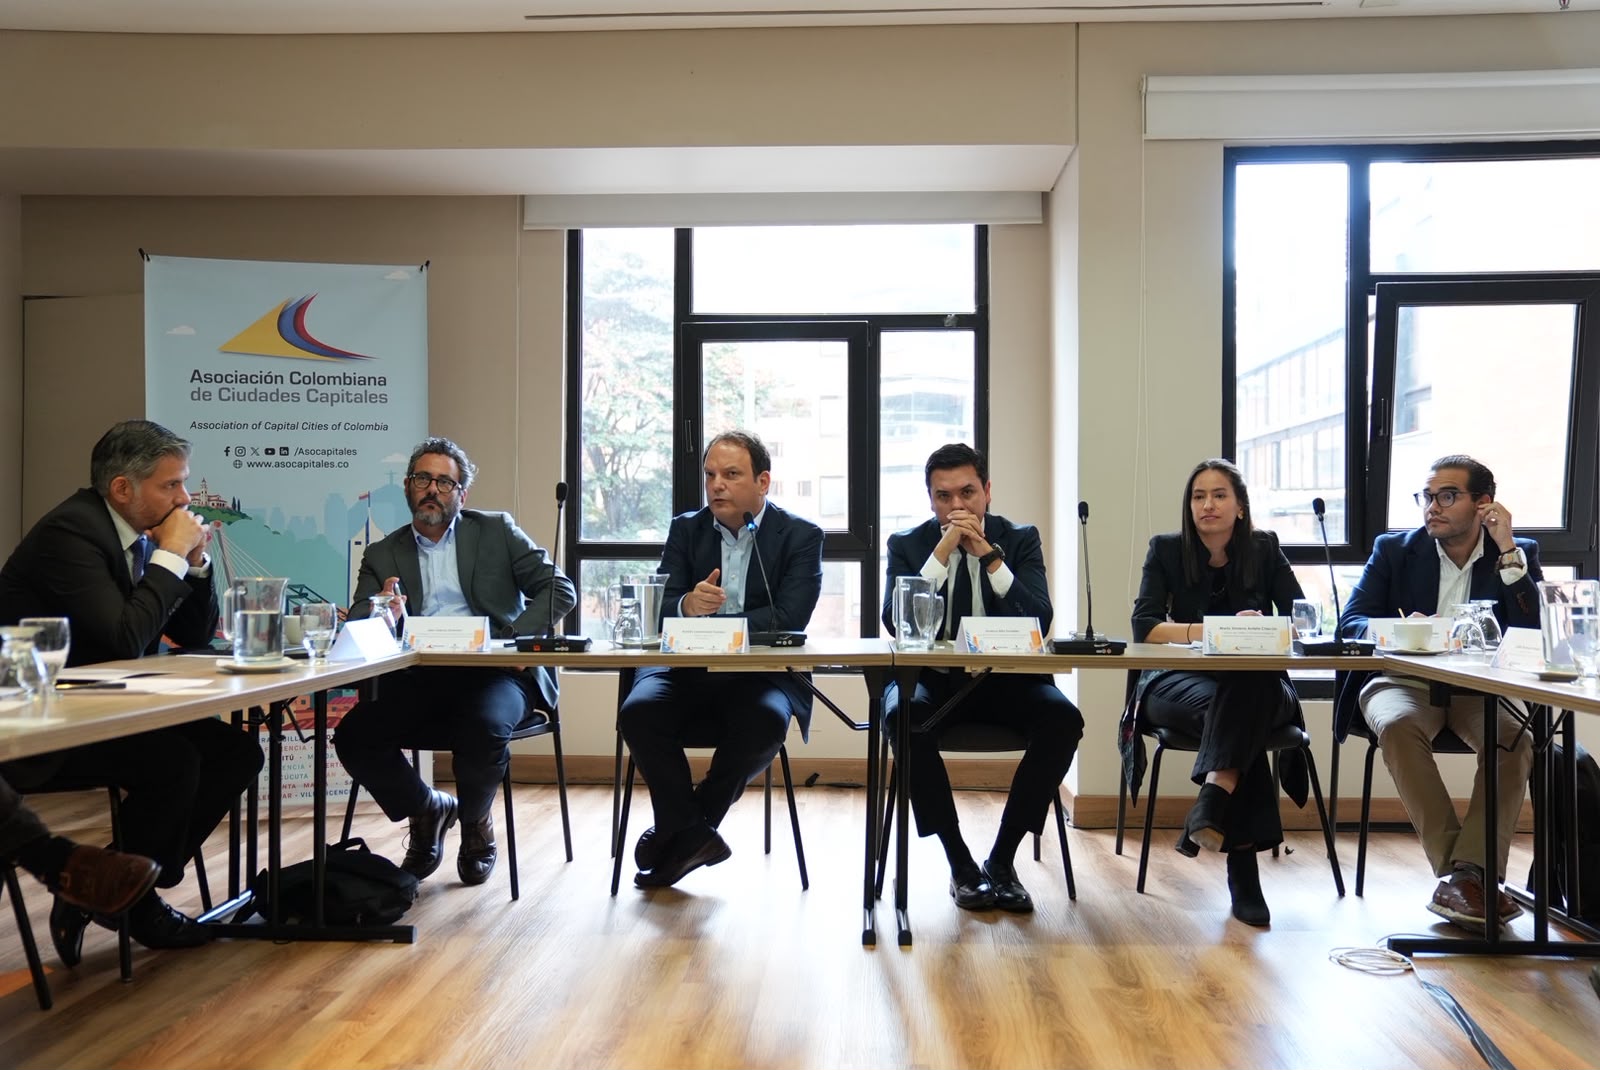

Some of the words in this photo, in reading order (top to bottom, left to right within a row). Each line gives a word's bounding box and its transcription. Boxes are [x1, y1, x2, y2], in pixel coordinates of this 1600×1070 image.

[190, 369, 284, 385] Asociación
[289, 371, 387, 386] Colombiana
[190, 387, 212, 402] de
[218, 387, 300, 403] Ciudades
[306, 388, 388, 407] Capitales
[190, 421, 249, 430] Association
[251, 421, 263, 430] of
[264, 421, 299, 432] Capital
[301, 422, 329, 431] Cities
[331, 422, 342, 431] of
[343, 422, 389, 432] Colombia
[294, 447, 358, 457] /Asocapitales
[246, 460, 349, 469] www.asocapitales.co
